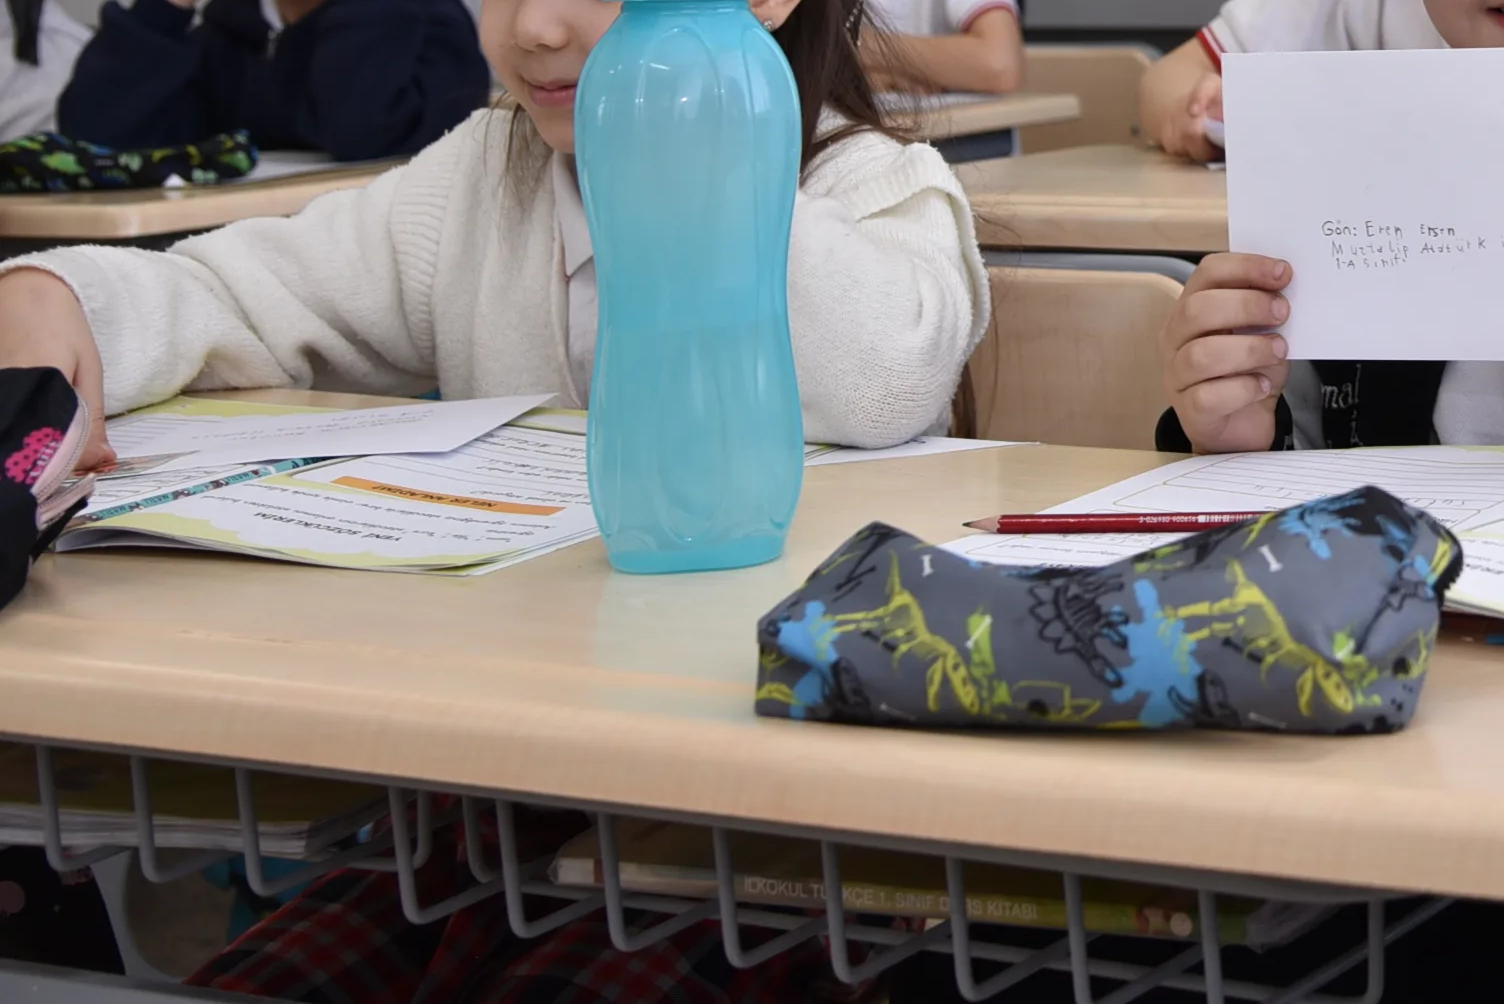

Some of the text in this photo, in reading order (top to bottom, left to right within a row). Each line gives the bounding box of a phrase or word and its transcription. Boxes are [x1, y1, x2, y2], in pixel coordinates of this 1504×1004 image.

[1321, 219, 1358, 237] Gön:
[1365, 220, 1403, 238] Eren
[371, 485, 497, 508] NELER ANLADIM?
[254, 512, 361, 537] SÖZCÜKLERİM
[360, 532, 402, 542] YENİ
[743, 876, 808, 897] İLKOKUL
[809, 879, 874, 908] TÜKÇE
[895, 892, 934, 910] SINIF
[939, 896, 982, 915] DRS
[986, 899, 1038, 920] KİTABI
